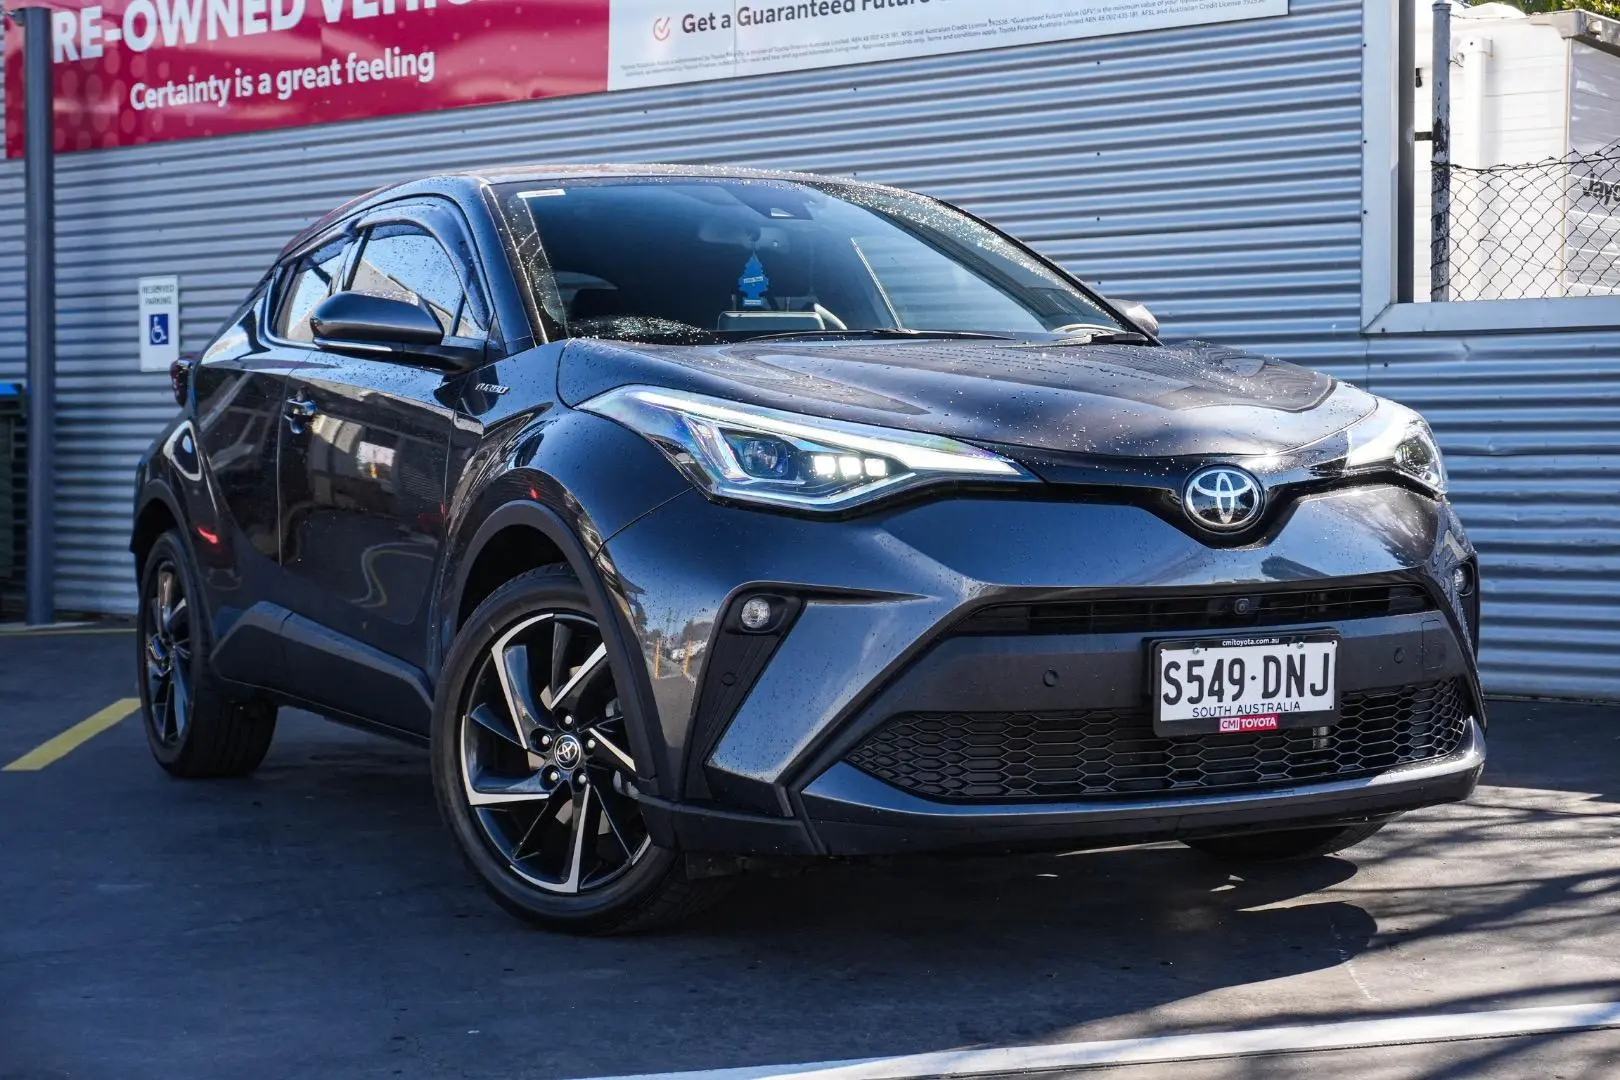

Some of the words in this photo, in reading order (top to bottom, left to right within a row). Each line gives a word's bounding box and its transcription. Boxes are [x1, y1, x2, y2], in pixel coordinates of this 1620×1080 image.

[682, 13, 716, 33] Get
[721, 13, 731, 29] a
[737, 0, 855, 27] Guaranteed
[53, 0, 305, 64] RE-OWNED
[130, 72, 230, 111] Certainty
[235, 68, 253, 98] is
[257, 72, 271, 94] a
[276, 57, 342, 100] great
[345, 46, 435, 82] feeling
[1222, 637, 1280, 647] cmitoyota.com.au
[1192, 705, 1232, 718] SOUTH
[1236, 701, 1301, 715] AUSTRALIA
[1240, 716, 1277, 729] TOYOTA
